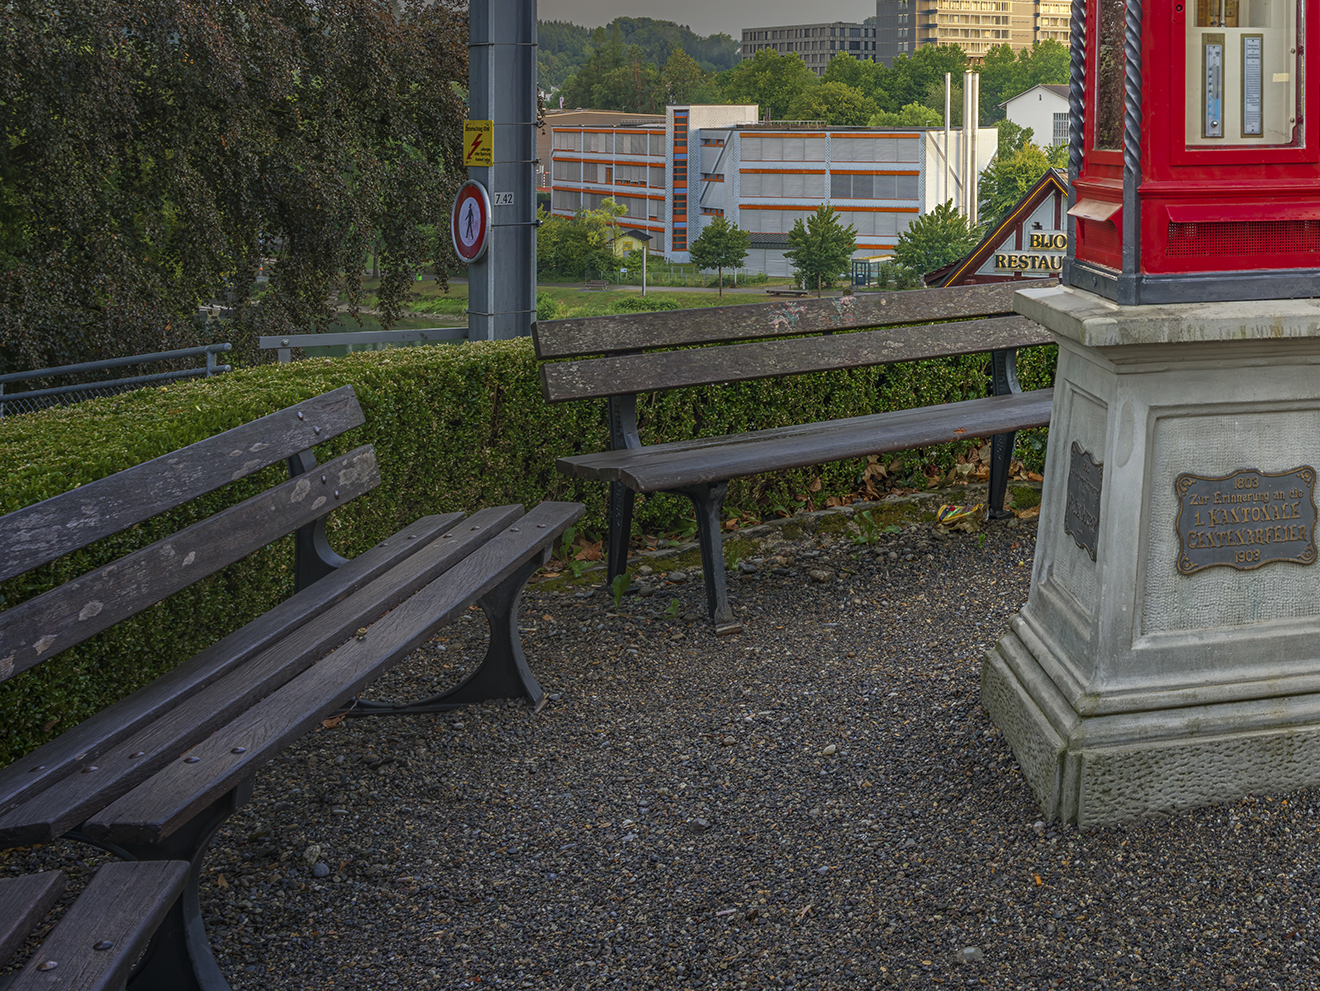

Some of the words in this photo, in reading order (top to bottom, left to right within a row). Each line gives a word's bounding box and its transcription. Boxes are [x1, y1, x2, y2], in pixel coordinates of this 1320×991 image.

[495, 193, 513, 205] 7.42
[1029, 234, 1067, 248] BIJO
[1234, 476, 1260, 490] 1803
[1189, 494, 1210, 506] Zur
[1213, 491, 1270, 504] Erinnerung
[1273, 490, 1285, 501] an
[1289, 488, 1304, 499] die
[1194, 511, 1205, 527] 1.
[1208, 502, 1301, 528] KANTONALE
[1187, 525, 1308, 549] CENTENARFEIER
[1234, 550, 1261, 564] 1903
